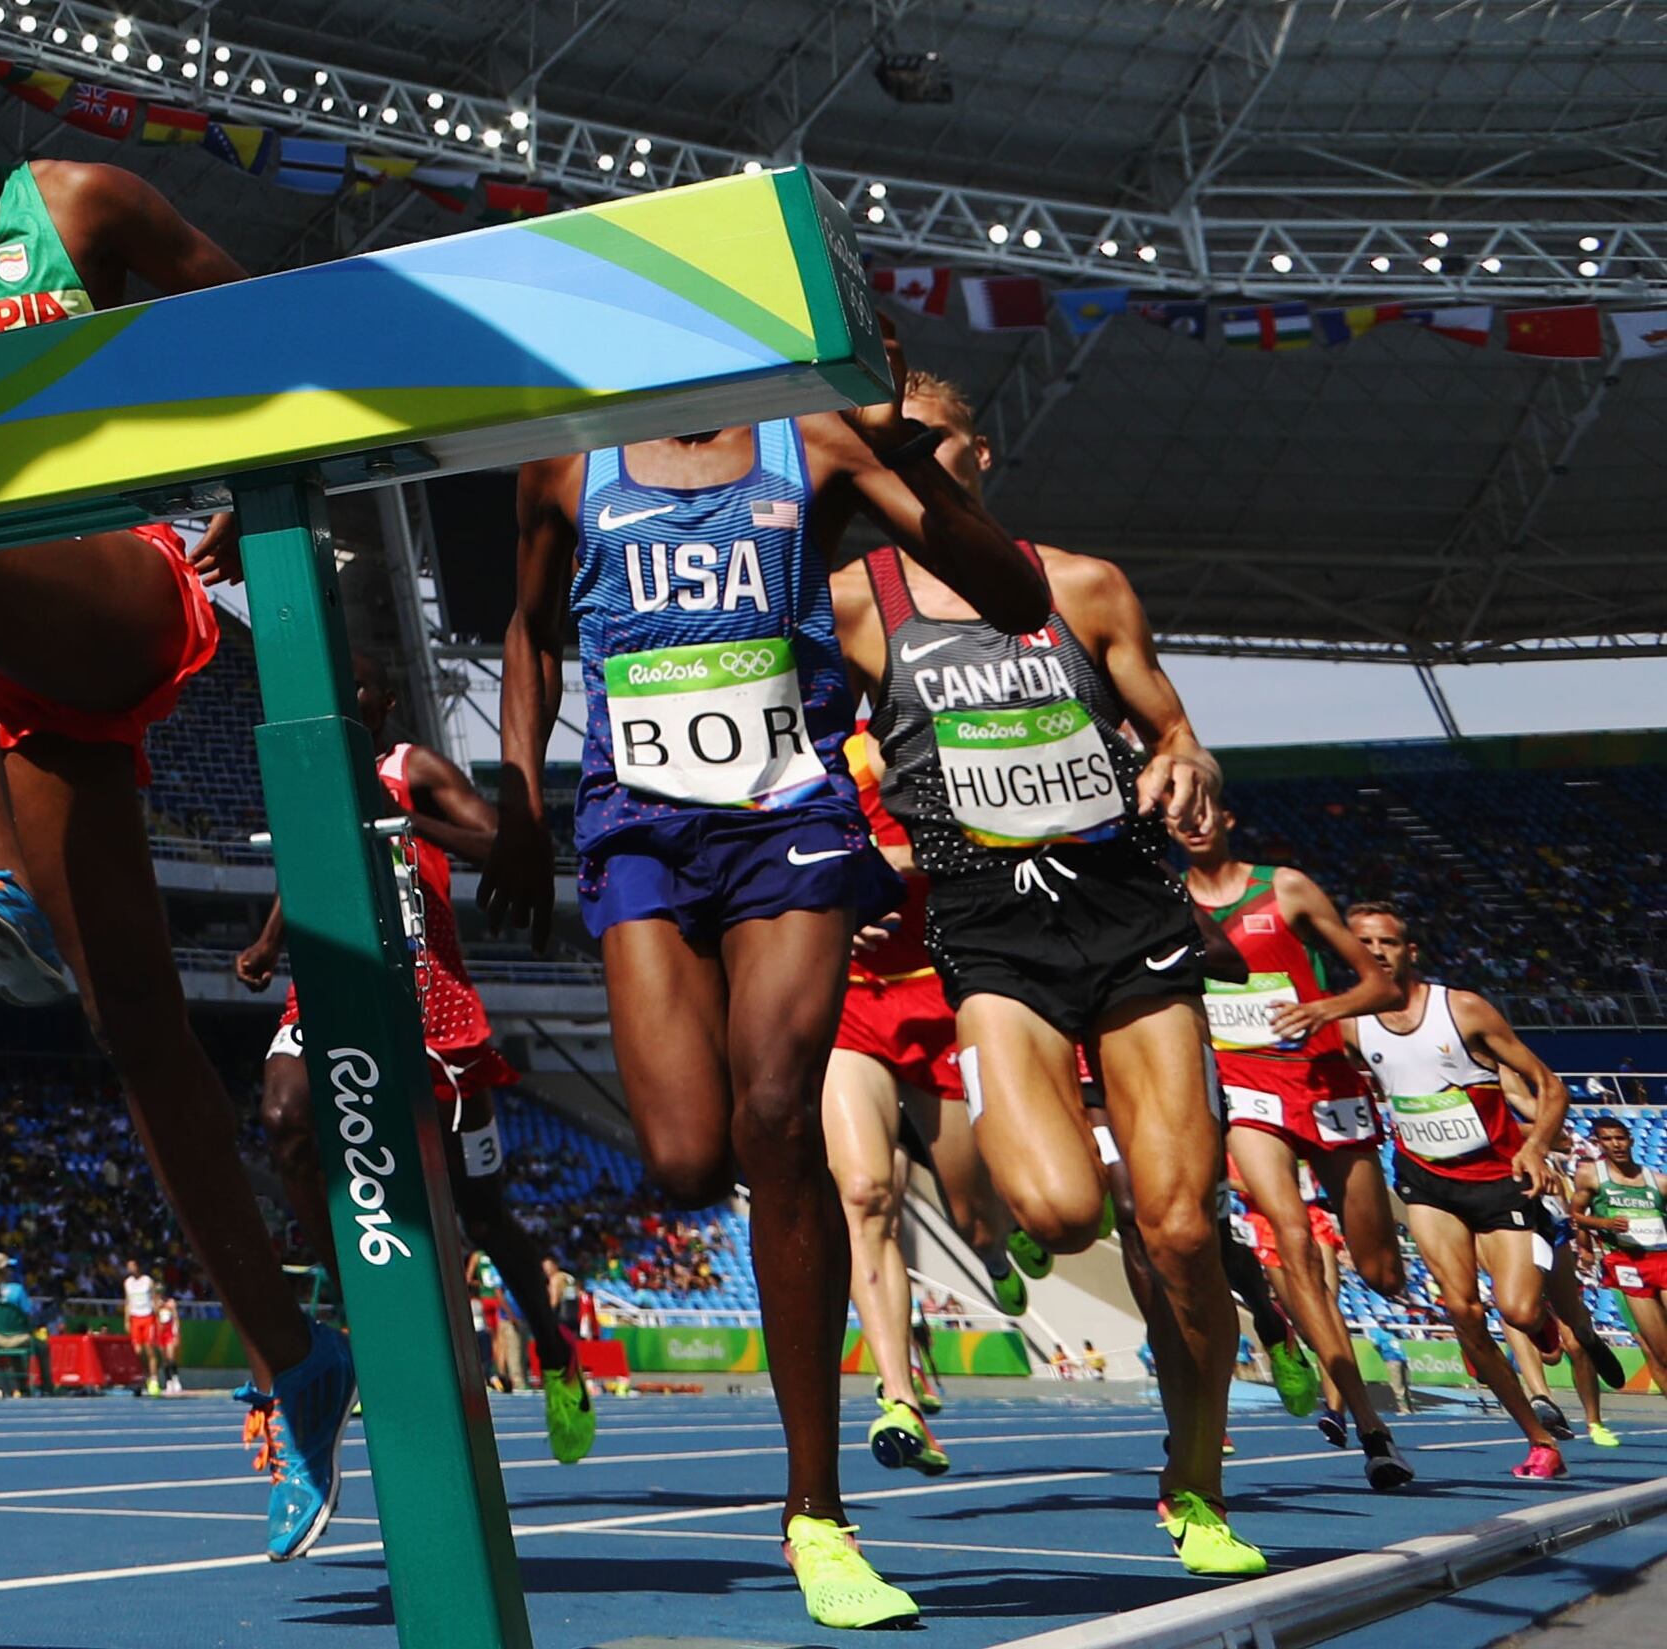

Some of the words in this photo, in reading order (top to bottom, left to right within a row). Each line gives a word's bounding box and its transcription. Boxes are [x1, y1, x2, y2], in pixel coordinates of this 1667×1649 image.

[625, 540, 770, 613] USA
[628, 658, 708, 685] Rio2016
[914, 656, 1077, 713] CANADA
[622, 705, 805, 766] BOR
[957, 721, 1028, 741] Rio2016
[950, 753, 1113, 808] HUGHES
[327, 1047, 412, 1266] Rio2016
[479, 1136, 496, 1167] 3
